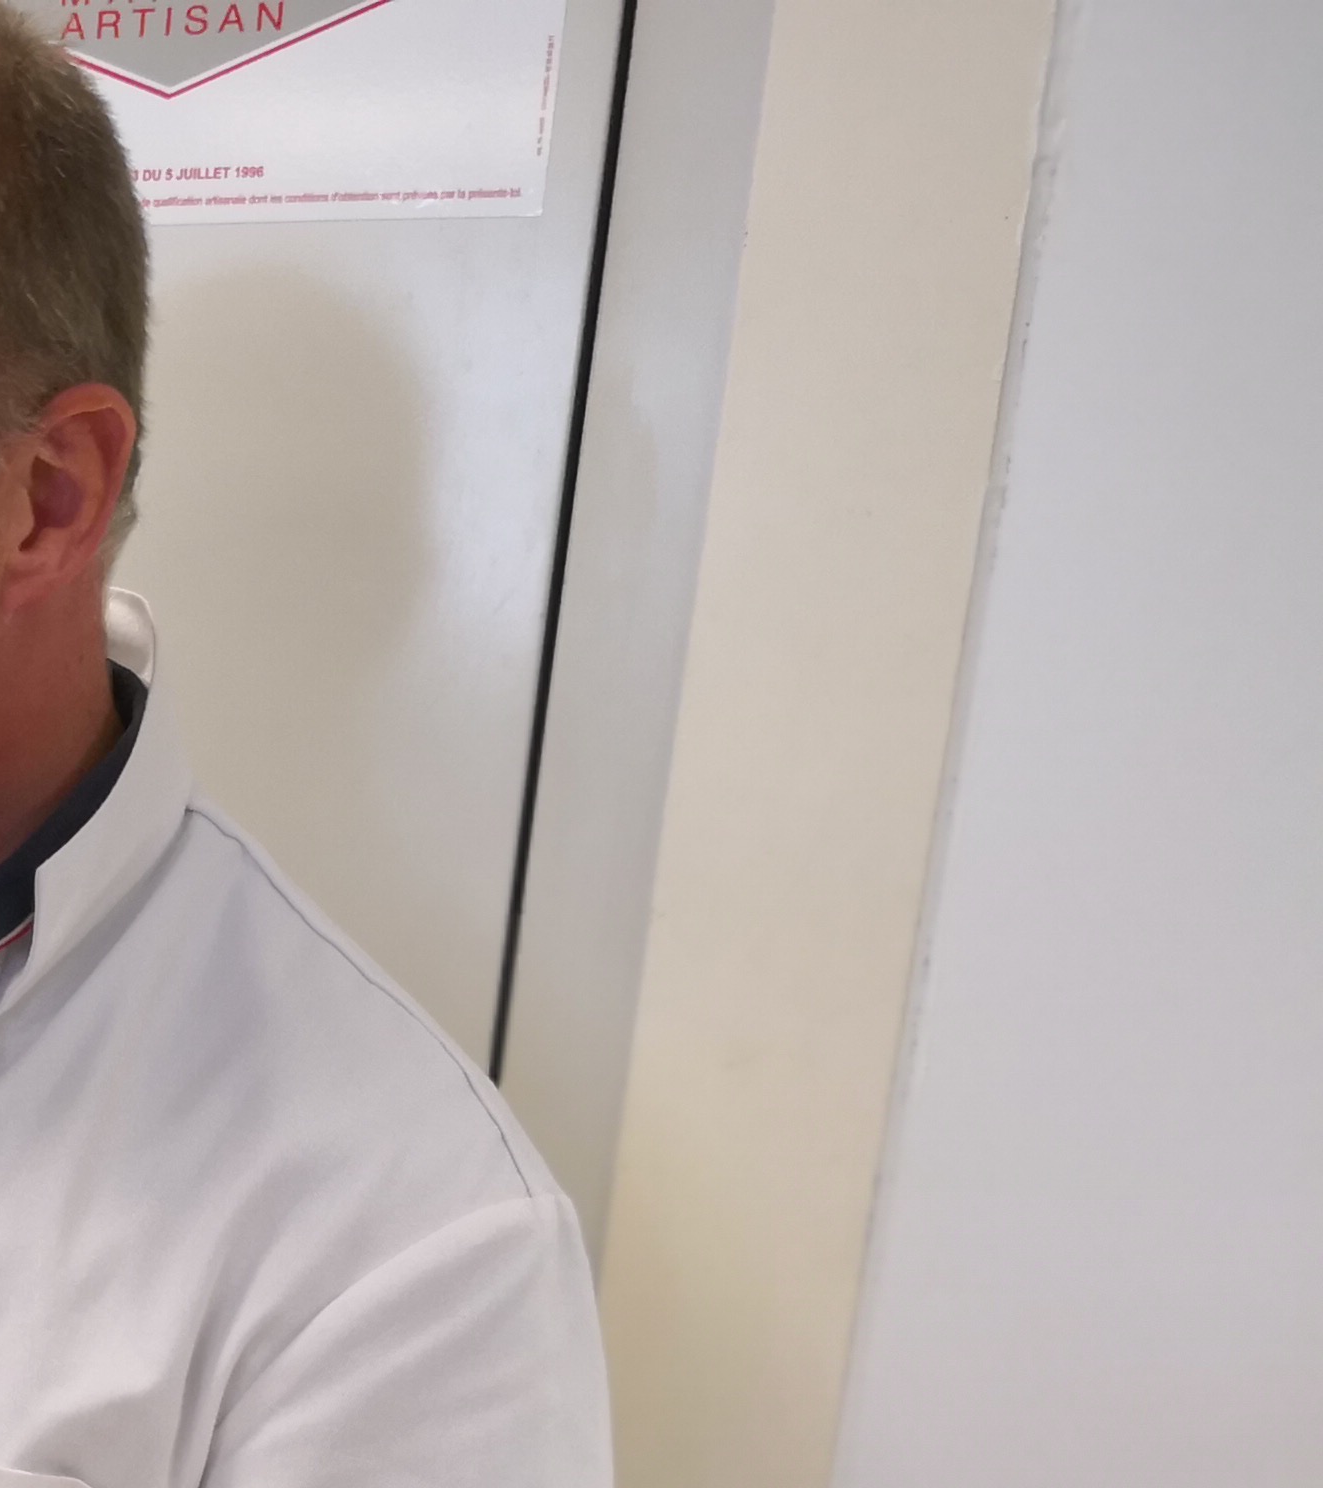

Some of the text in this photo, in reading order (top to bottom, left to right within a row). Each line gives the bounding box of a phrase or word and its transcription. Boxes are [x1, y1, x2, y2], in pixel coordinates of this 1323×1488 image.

[61, 1, 285, 40] ARTISAN
[142, 169, 161, 182] DU
[176, 166, 231, 181] JUILLET
